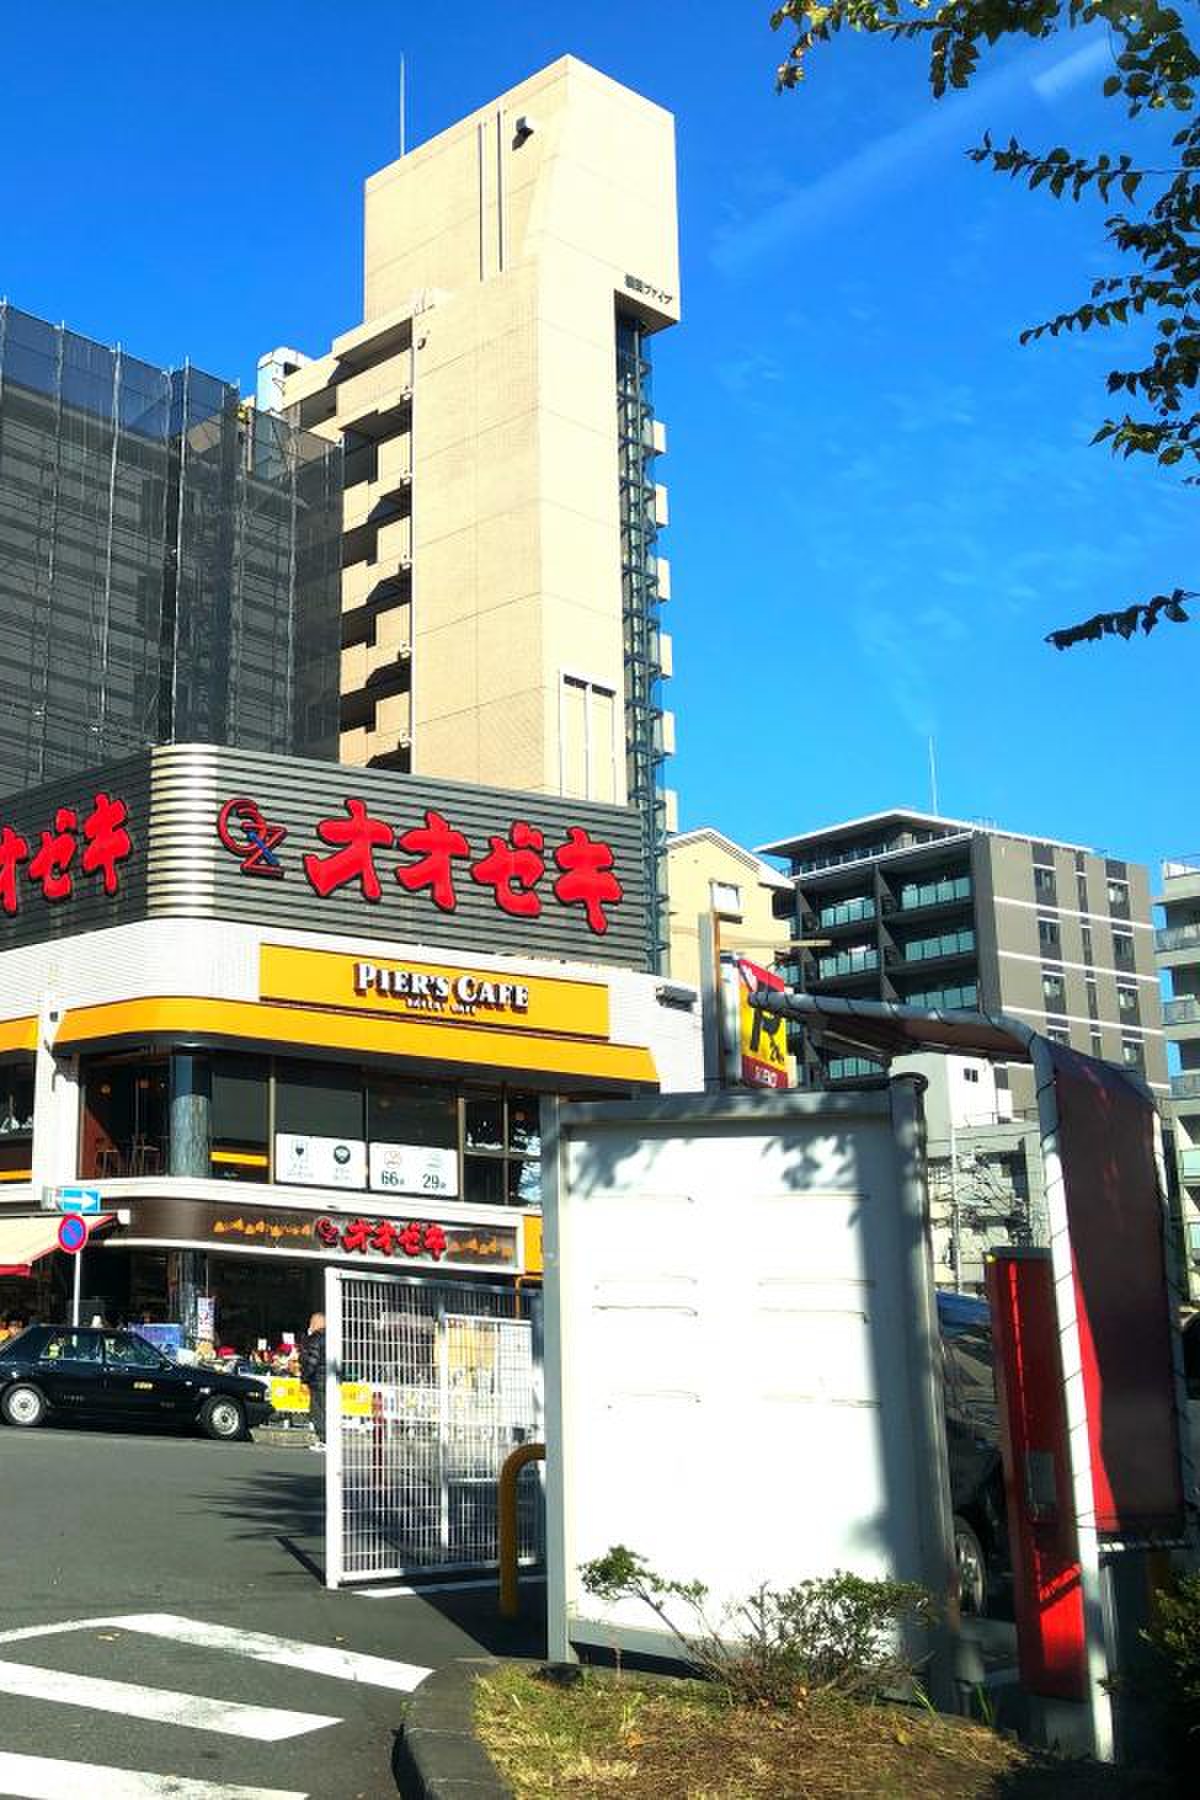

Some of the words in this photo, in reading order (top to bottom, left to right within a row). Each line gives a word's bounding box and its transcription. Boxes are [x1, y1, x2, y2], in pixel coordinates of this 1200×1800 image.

[302, 798, 624, 935] オオゼキ
[354, 962, 449, 1000] PIER'S
[455, 975, 529, 1013] CAFE
[340, 1216, 448, 1262] オオゼキ
